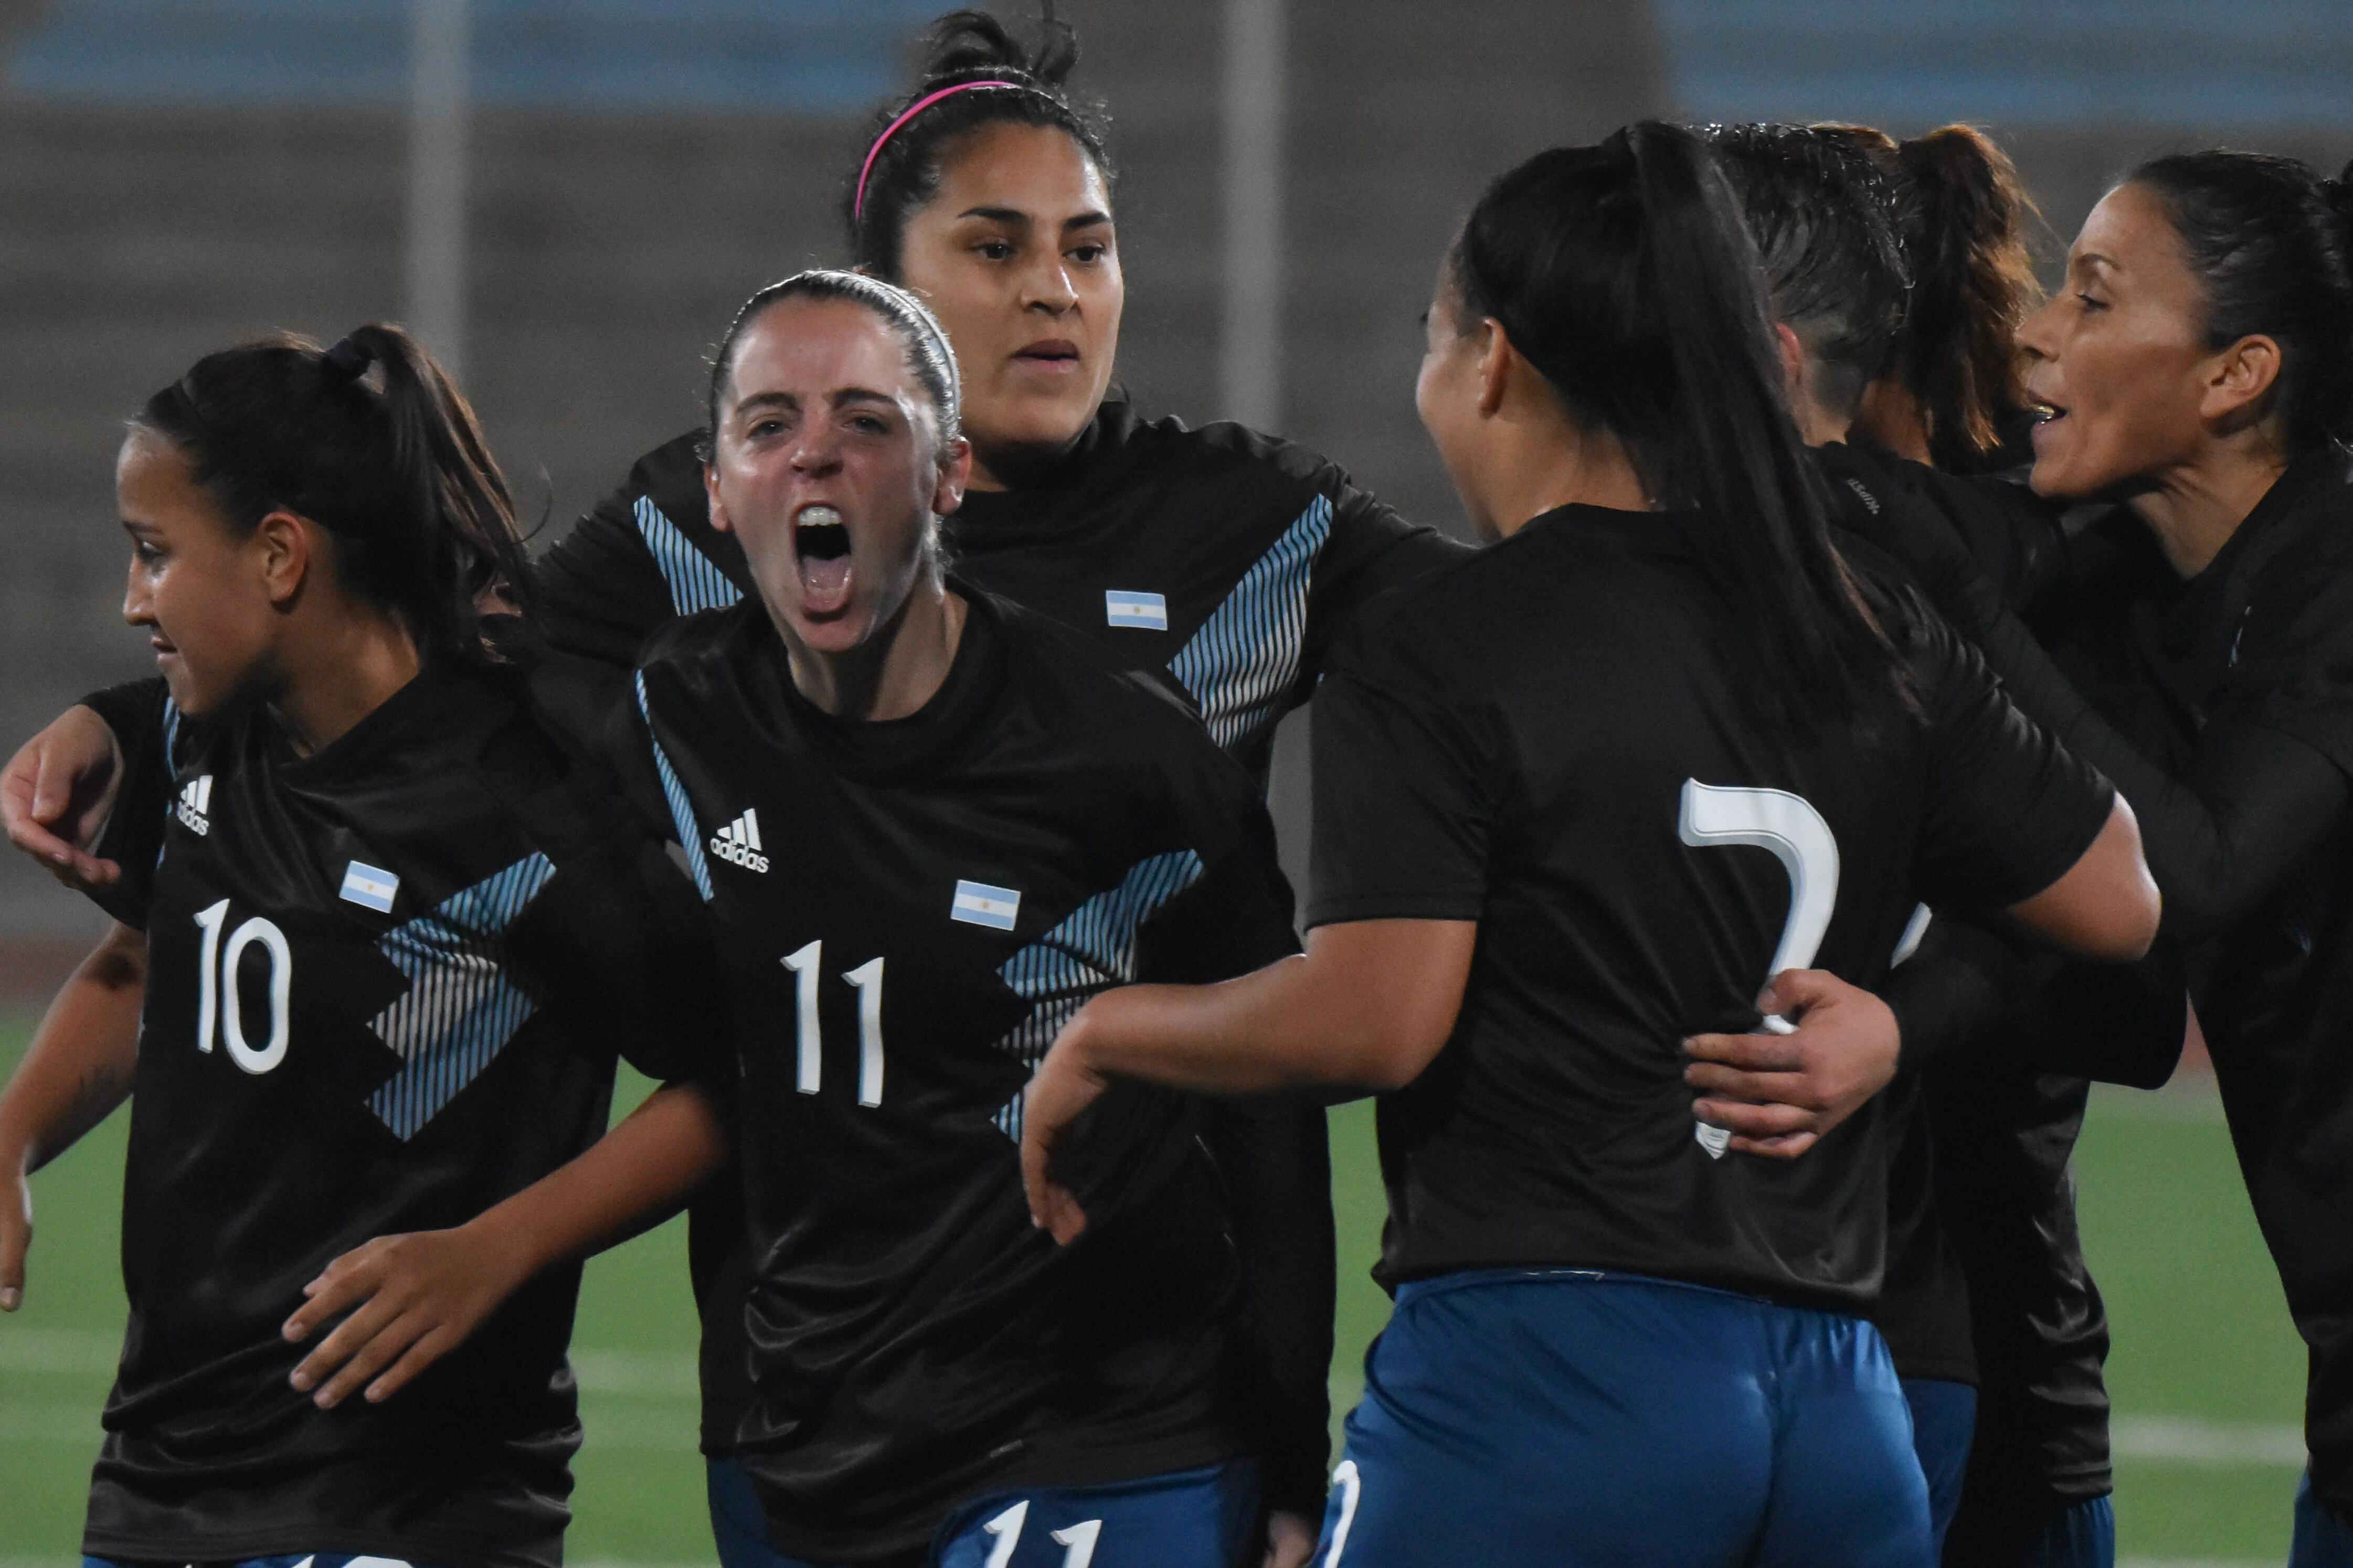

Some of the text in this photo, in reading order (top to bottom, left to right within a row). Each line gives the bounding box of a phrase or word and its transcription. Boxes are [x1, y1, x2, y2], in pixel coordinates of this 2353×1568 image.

[710, 838, 770, 873] adidas
[193, 898, 292, 1075] 10
[780, 940, 885, 1108] 11
[1679, 777, 1840, 1160] 7
